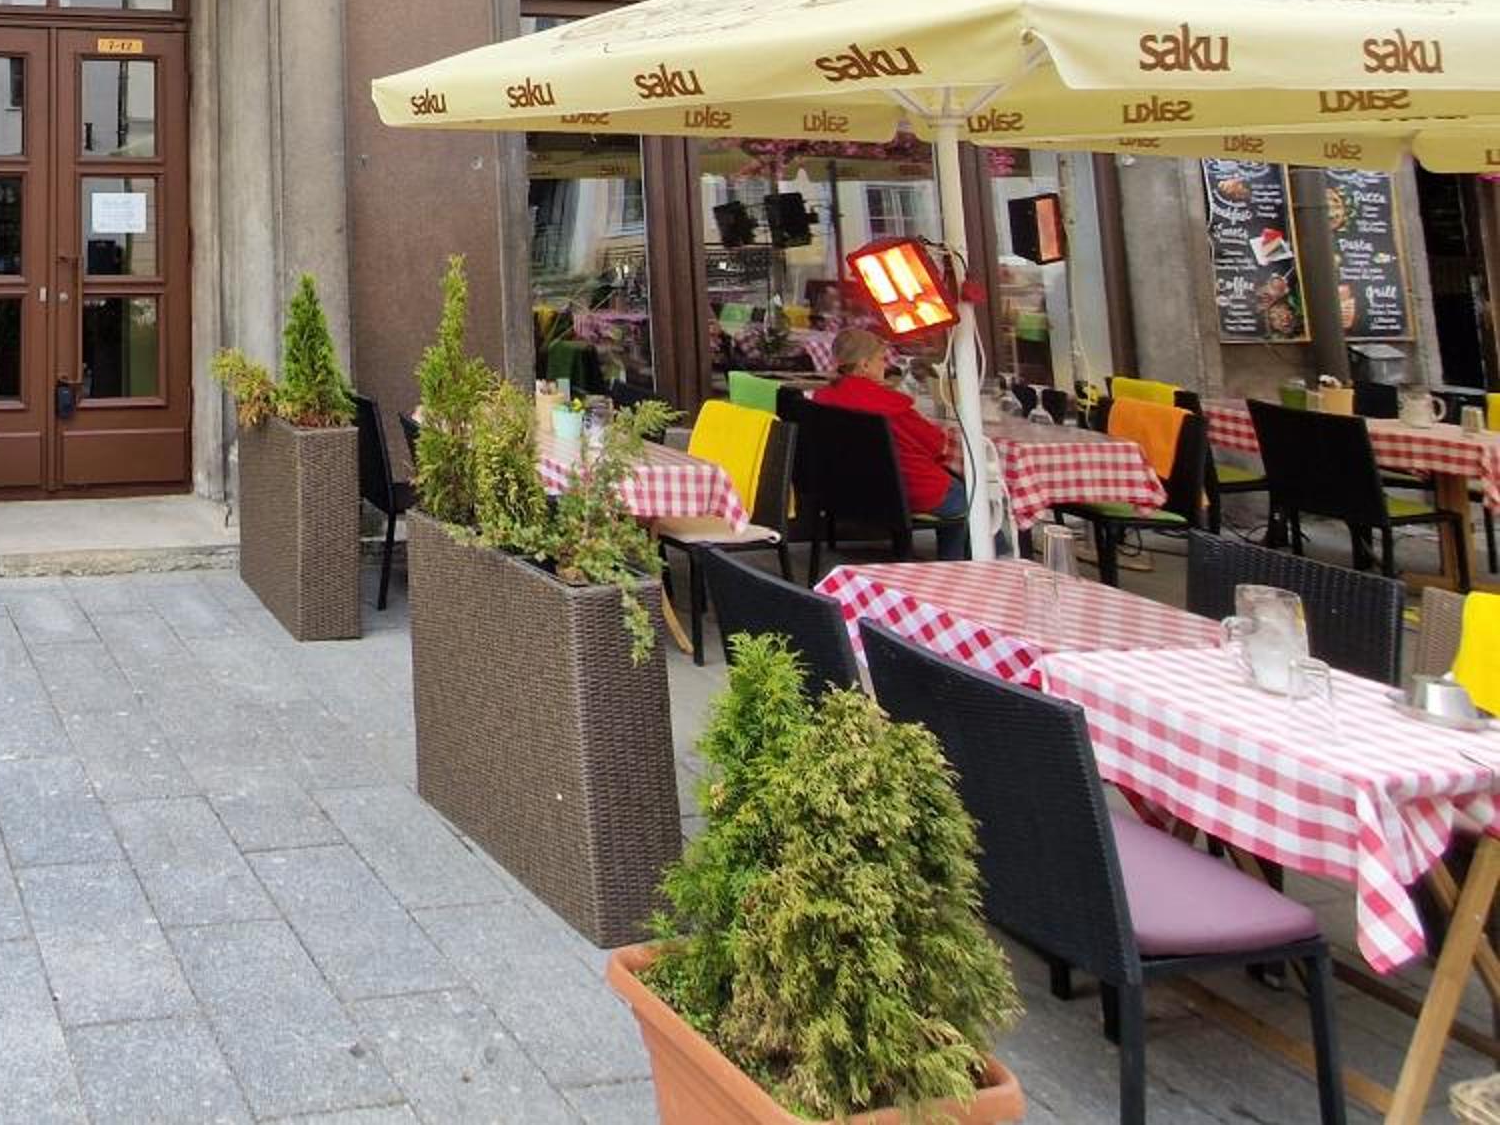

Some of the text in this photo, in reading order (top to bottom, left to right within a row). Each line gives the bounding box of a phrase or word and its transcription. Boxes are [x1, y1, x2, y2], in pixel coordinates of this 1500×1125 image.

[815, 43, 922, 82] saku
[1140, 23, 1230, 72] saku
[1363, 29, 1444, 74] saku
[507, 78, 556, 109] saku
[634, 63, 704, 99] saku
[411, 88, 448, 115] saku
